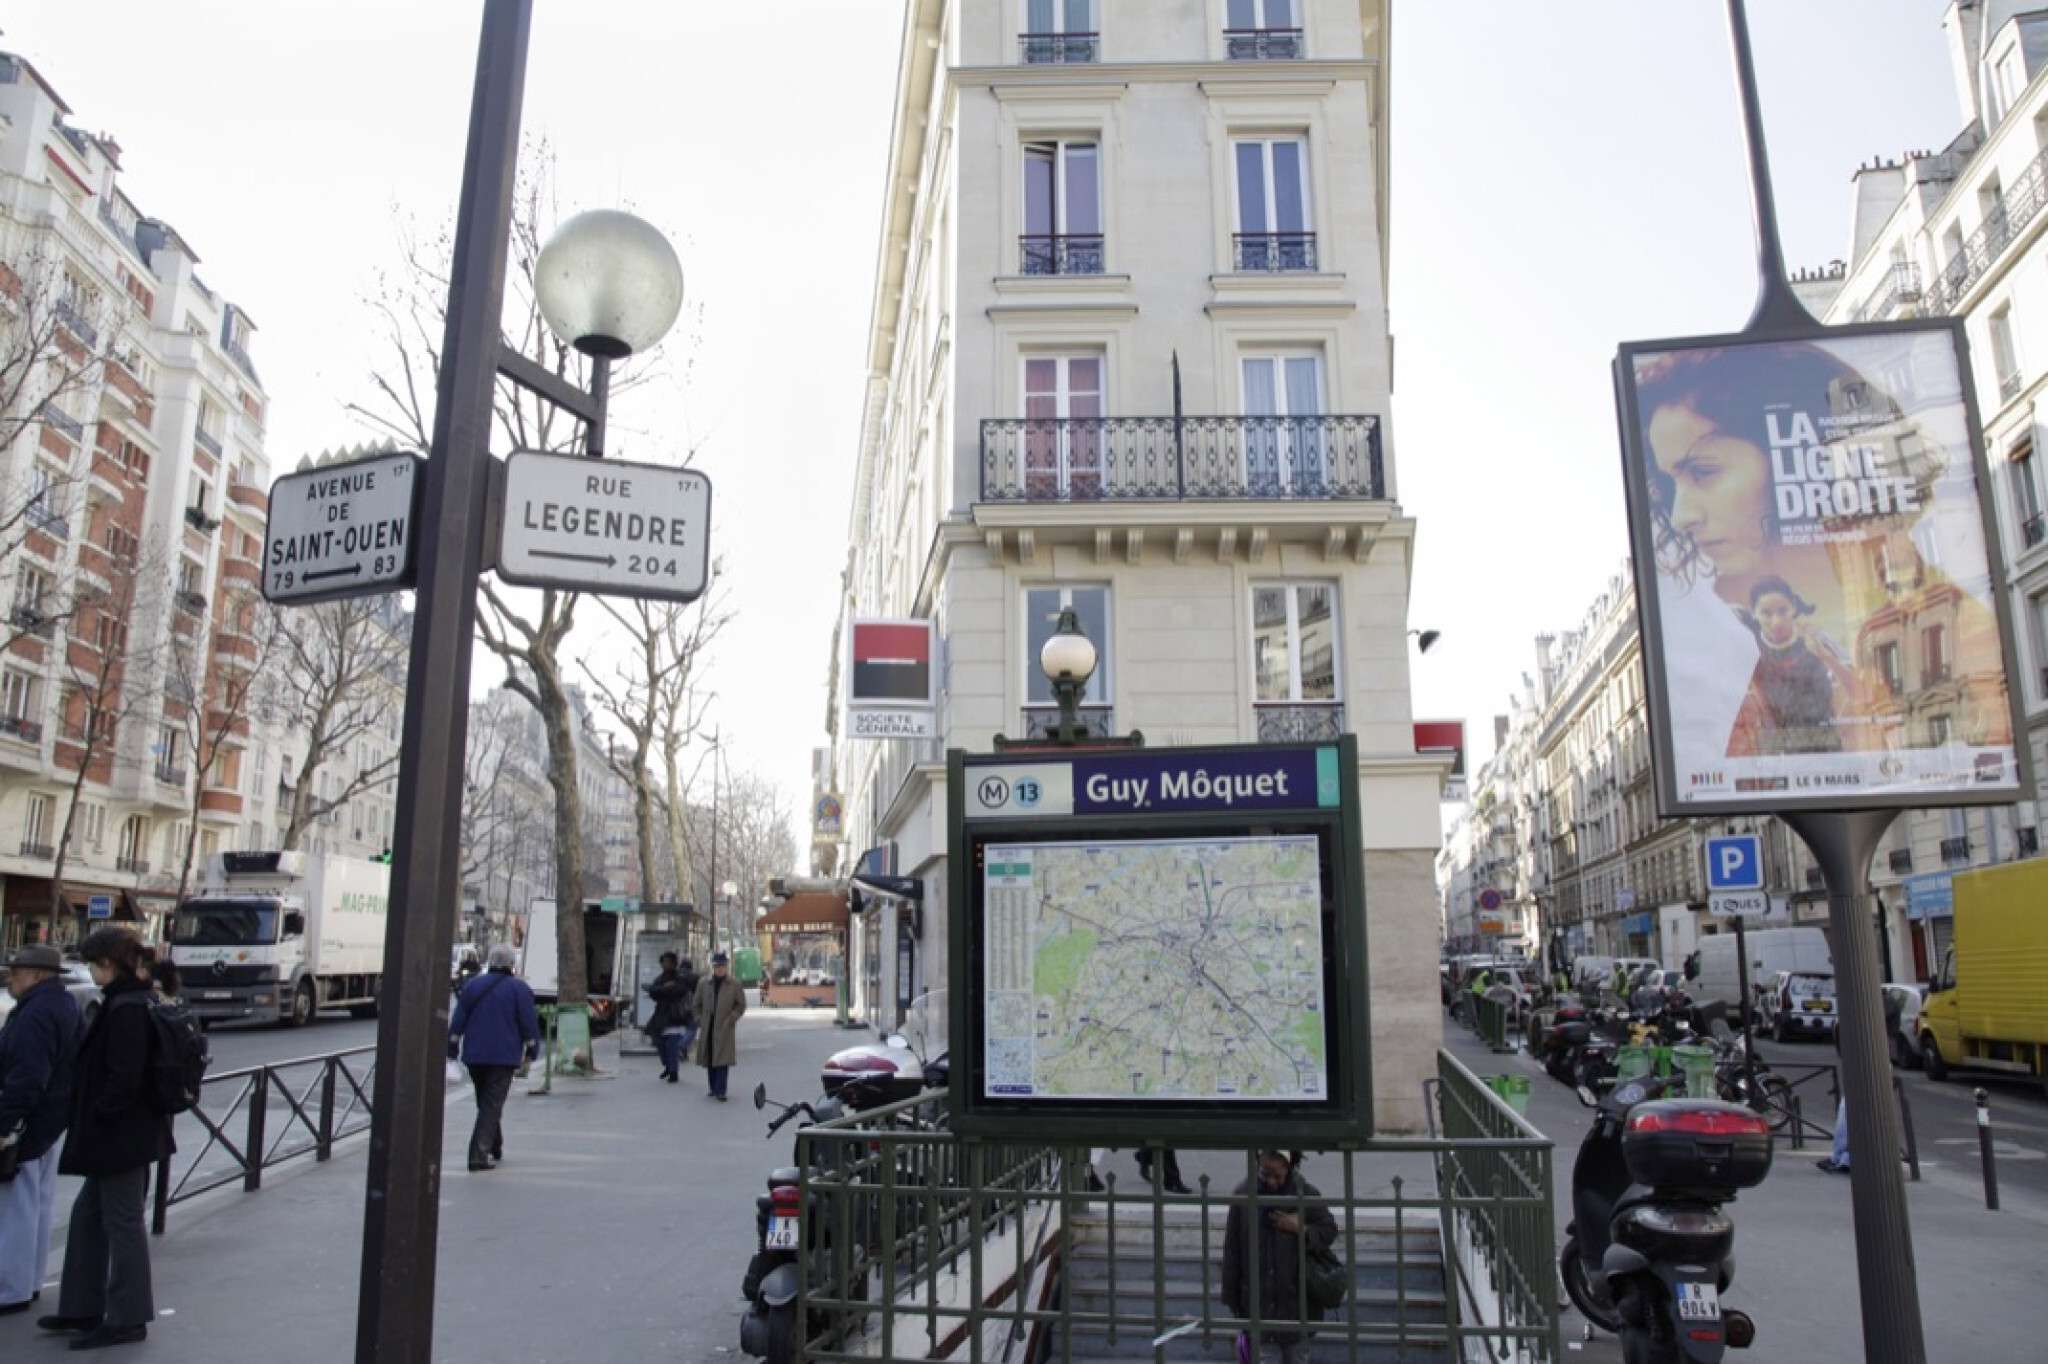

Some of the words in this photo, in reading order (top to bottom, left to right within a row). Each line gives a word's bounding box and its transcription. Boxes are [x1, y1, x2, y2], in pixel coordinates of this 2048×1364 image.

[1766, 412, 1820, 447] LA
[1772, 442, 1888, 482] LIGNE
[307, 472, 376, 501] AVENUE
[586, 475, 632, 498] RUE
[1775, 476, 1921, 520] DROITE
[327, 503, 350, 522] DE
[523, 500, 687, 547] LEGENDRE
[271, 517, 404, 566] SAINT-OUEN
[272, 570, 295, 591] 79
[373, 554, 397, 576] 83
[627, 554, 678, 578] 204
[1015, 783, 1039, 802] 13
[1086, 773, 1150, 806] Guy
[1160, 768, 1289, 804] Môquet
[1824, 774, 1861, 786] MARS
[1721, 847, 1745, 879] P
